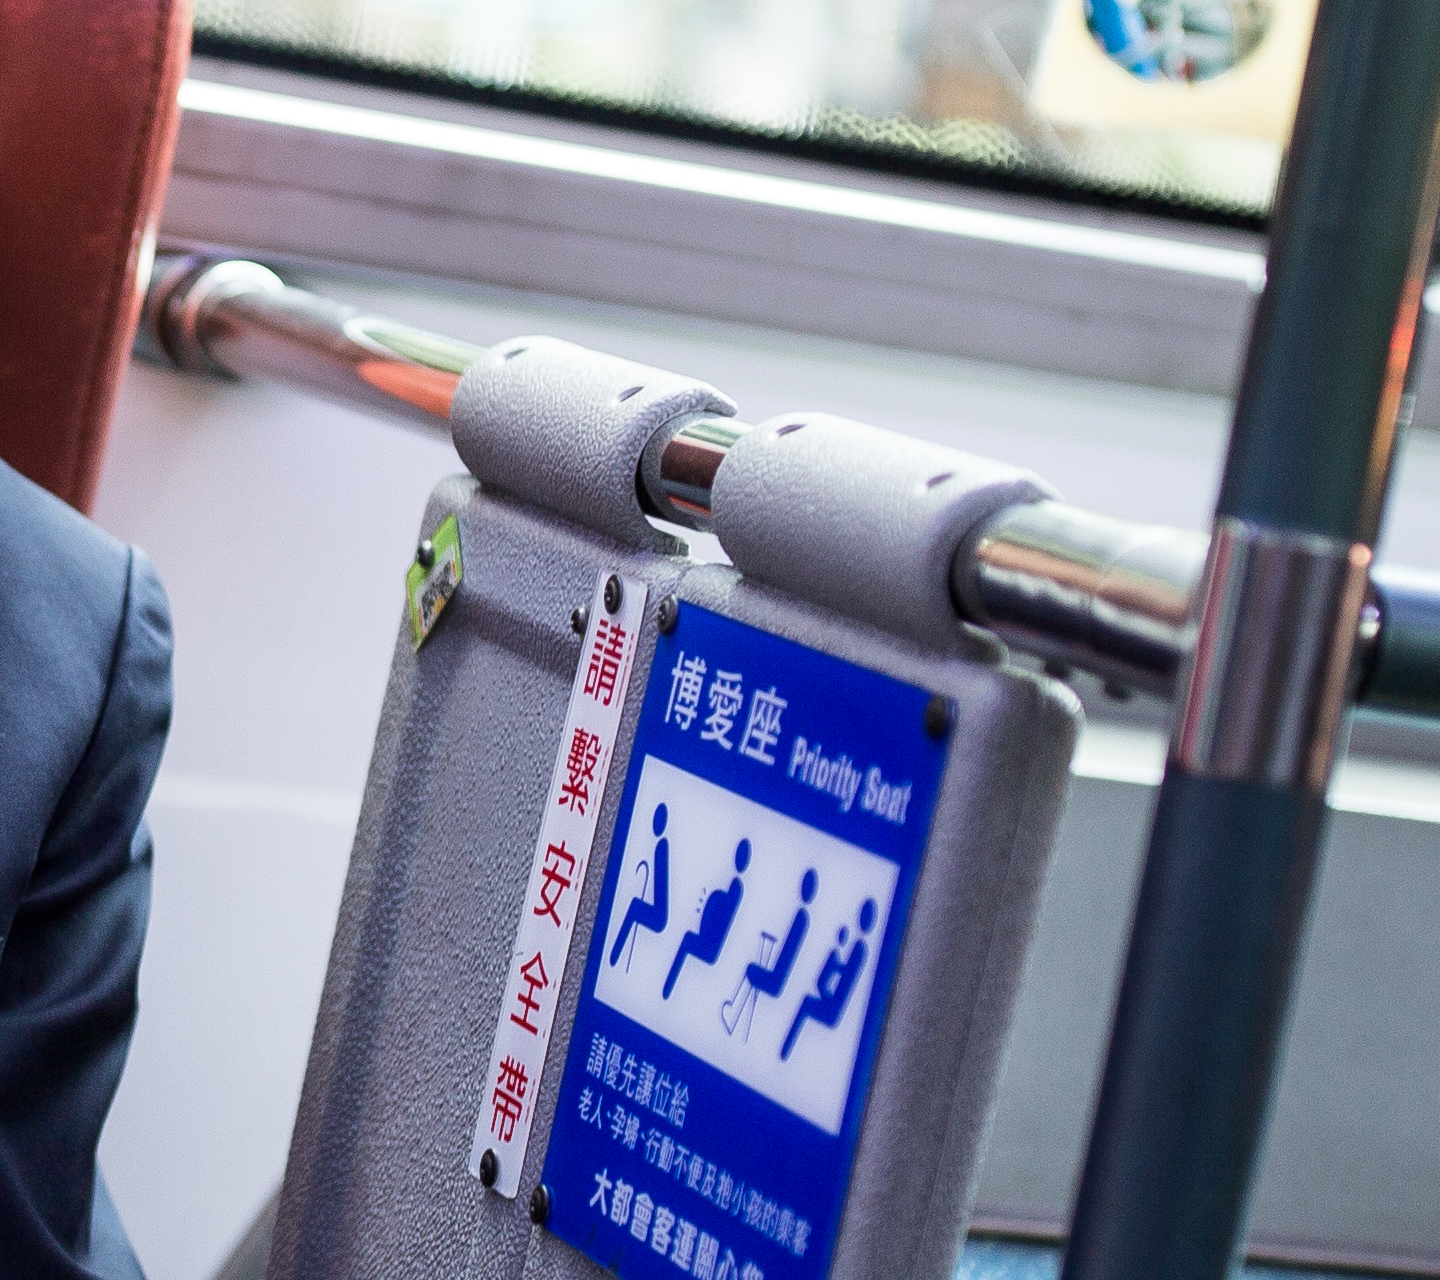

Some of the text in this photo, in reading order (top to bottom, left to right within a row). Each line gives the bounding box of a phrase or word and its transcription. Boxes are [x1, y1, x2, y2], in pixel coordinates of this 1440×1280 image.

[664, 650, 788, 766] 博愛座
[787, 735, 912, 824] Priority Seat
[490, 618, 627, 1145] 請繫安全帶
[586, 1032, 690, 1128] 請優先讓位給
